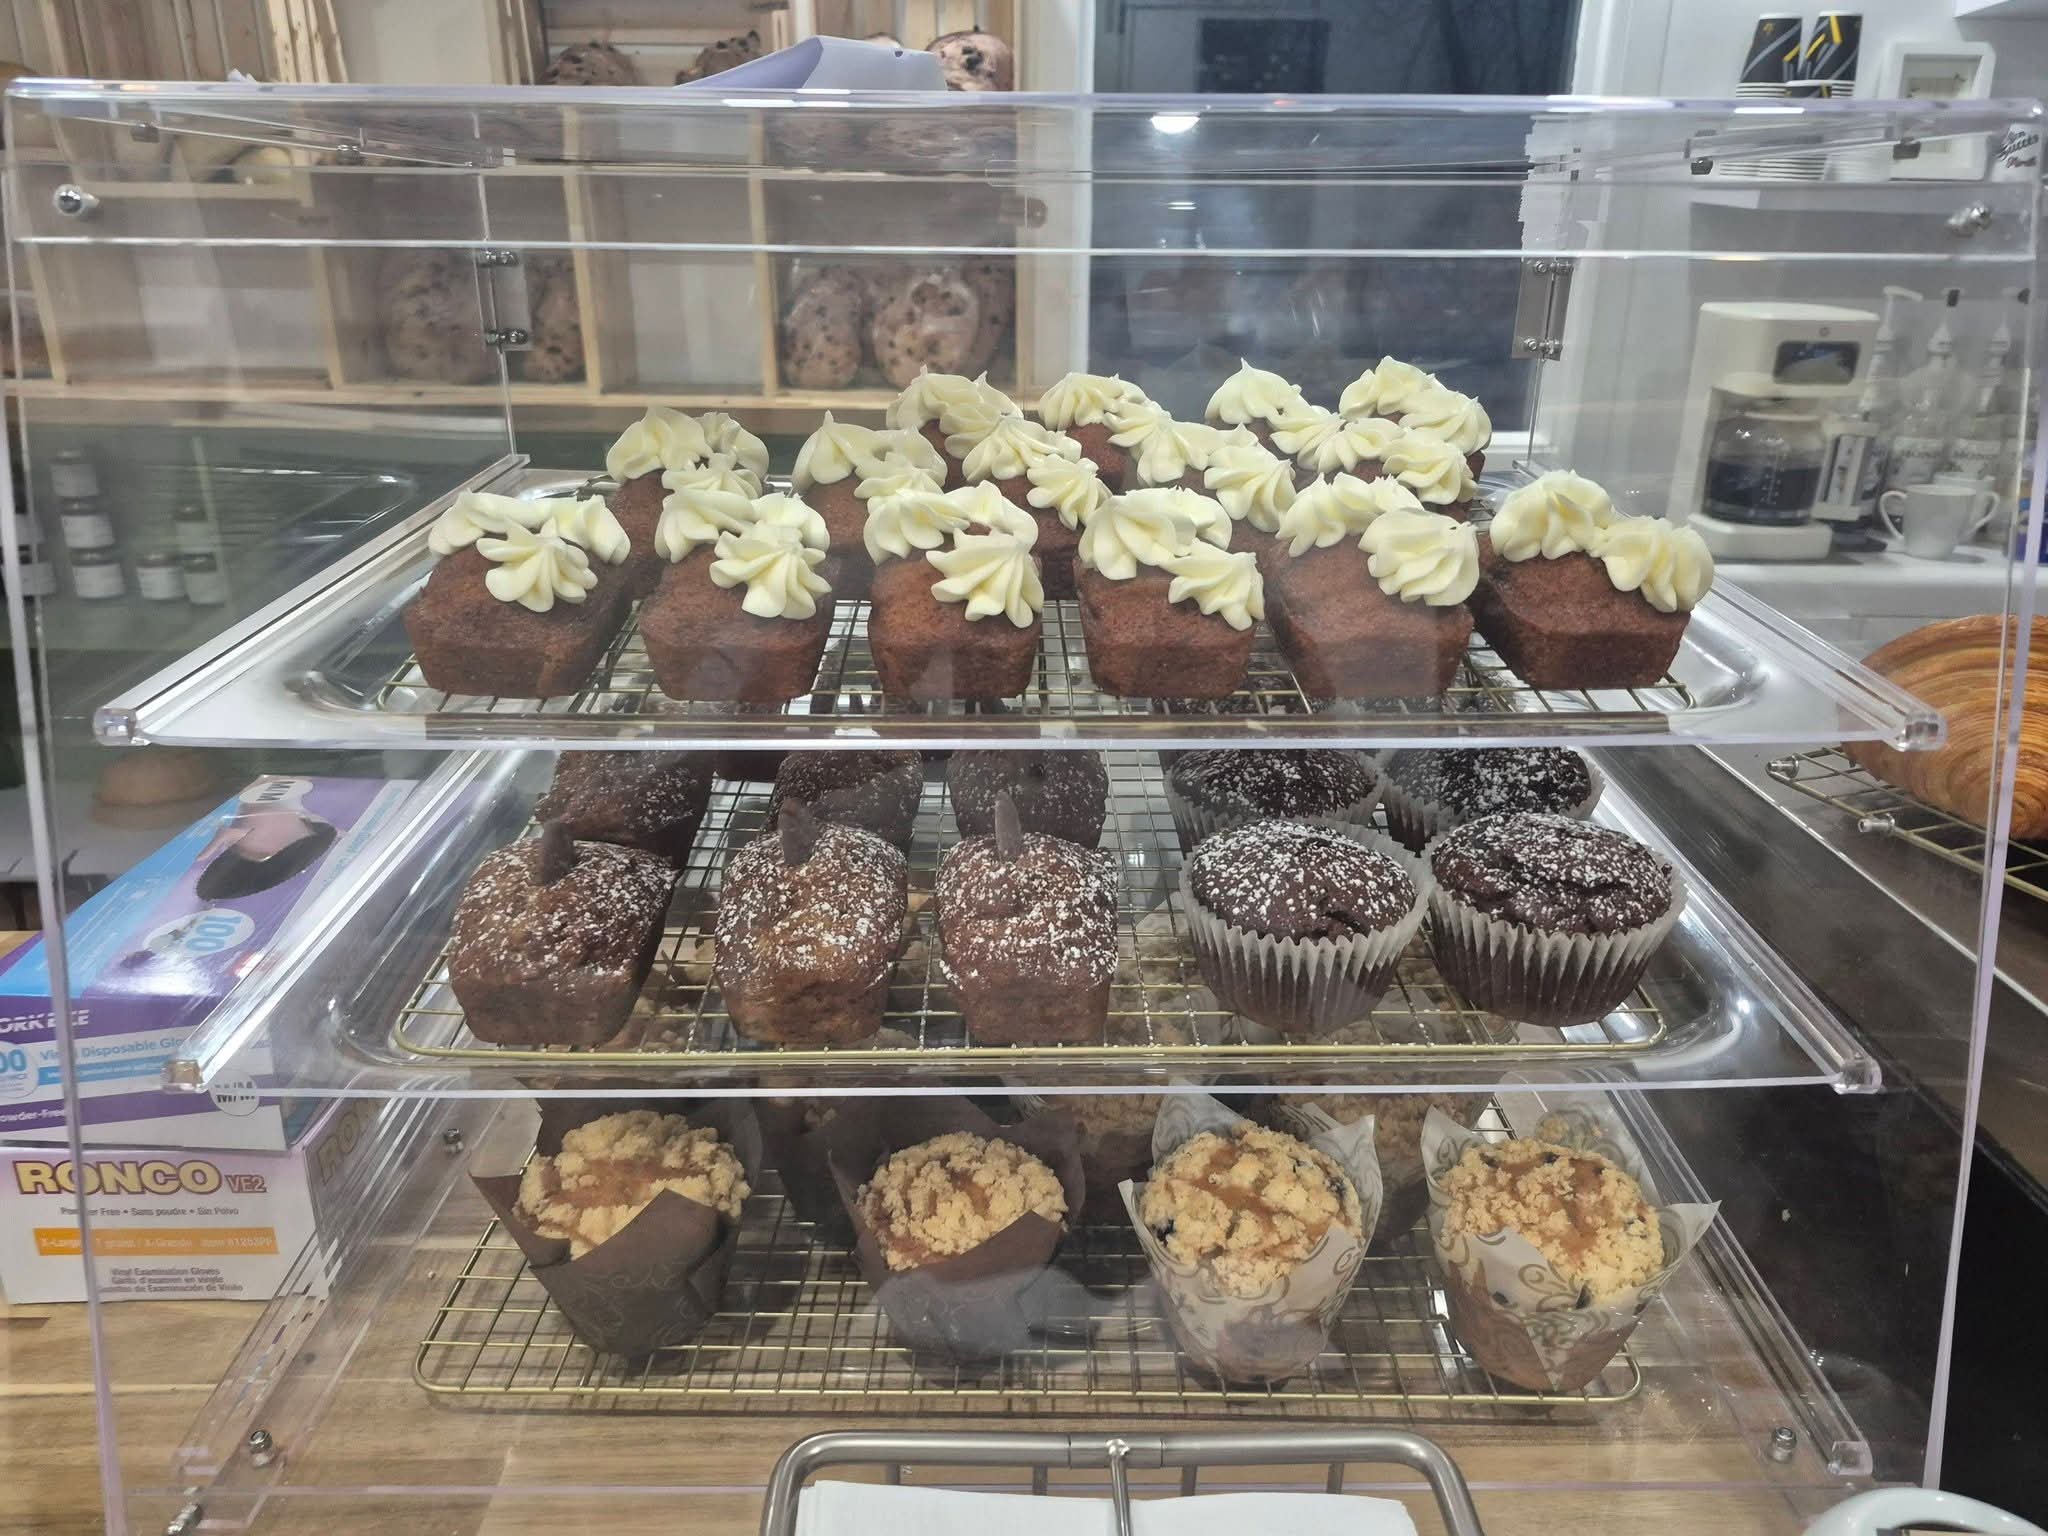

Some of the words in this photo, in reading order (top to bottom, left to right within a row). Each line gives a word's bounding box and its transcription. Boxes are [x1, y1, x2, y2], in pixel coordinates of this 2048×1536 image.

[81, 1039, 157, 1058] Disposable
[12, 1159, 223, 1196] RONCO
[224, 1173, 268, 1194] VE2
